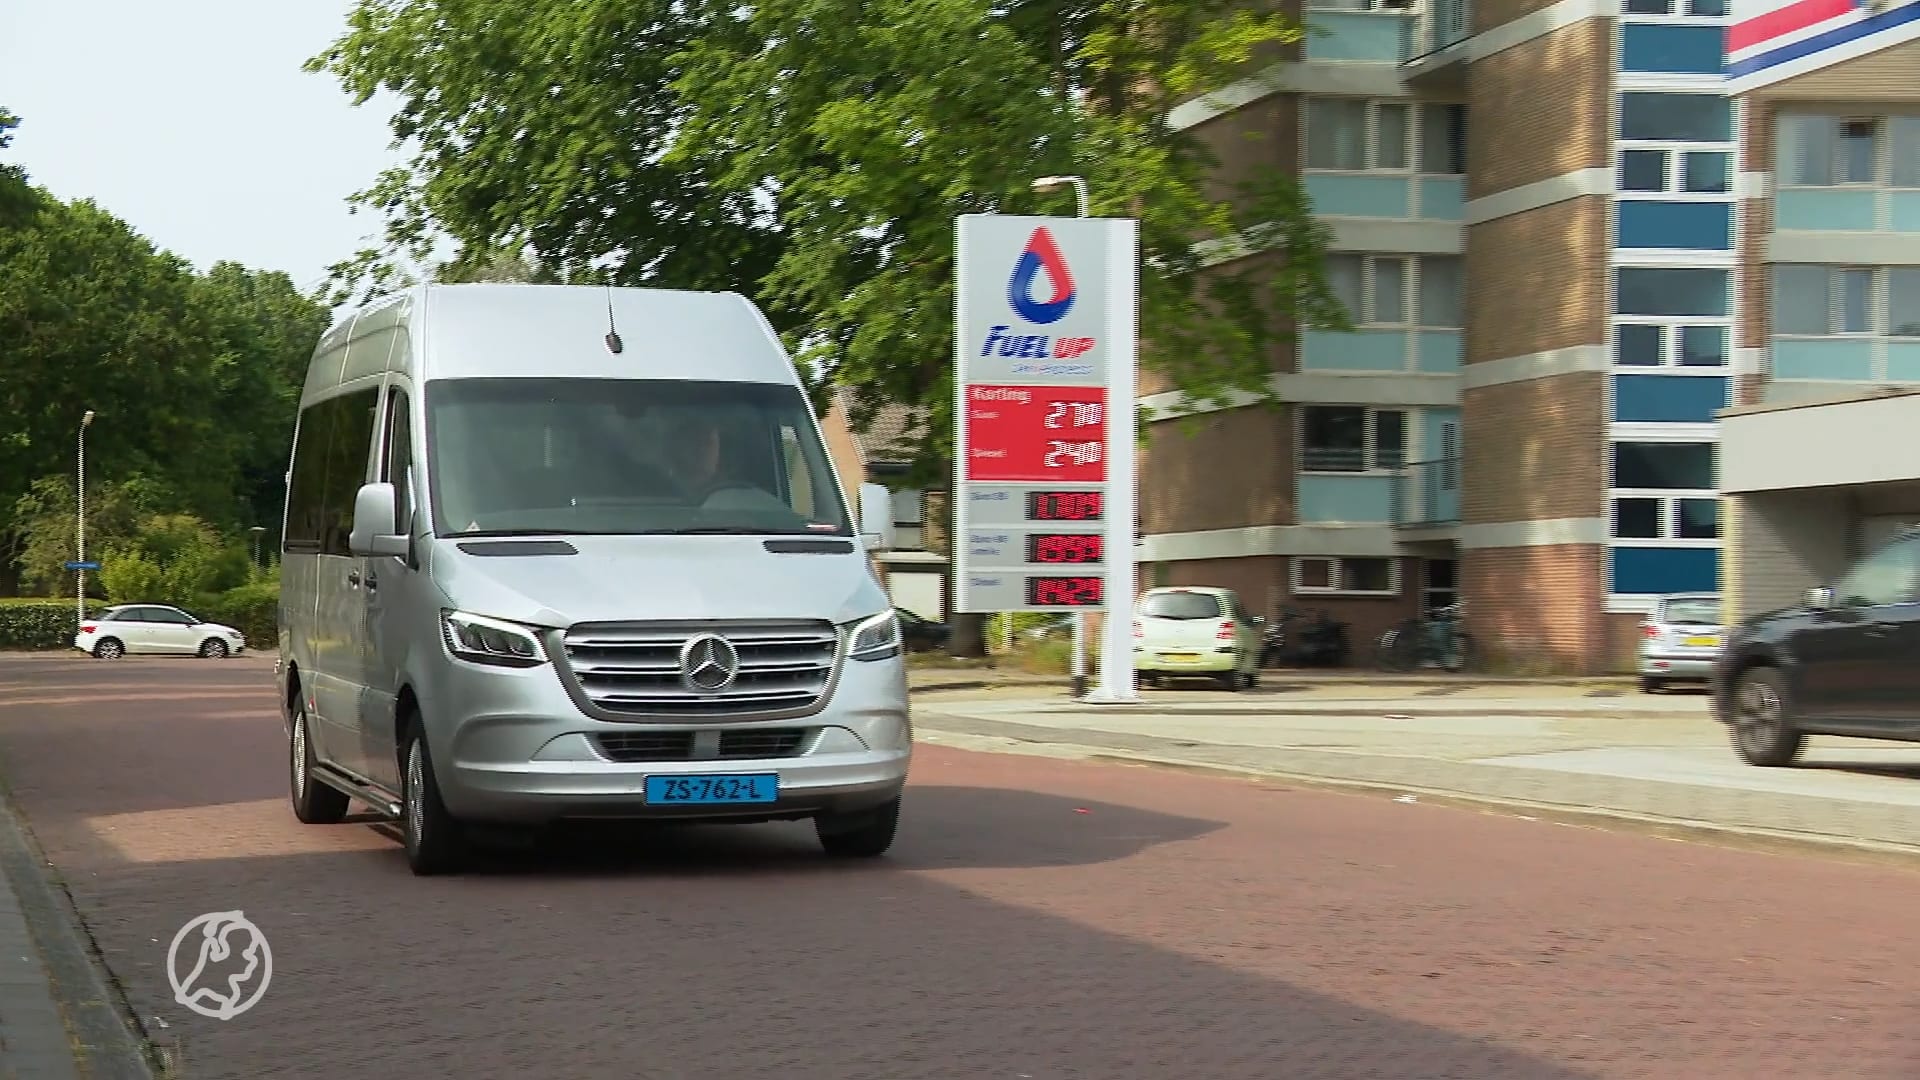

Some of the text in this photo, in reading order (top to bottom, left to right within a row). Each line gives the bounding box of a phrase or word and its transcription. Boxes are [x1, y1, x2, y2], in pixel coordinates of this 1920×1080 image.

[981, 325, 1097, 358] FUEL UP
[973, 387, 1032, 405] Korting
[1044, 401, 1102, 428] 270
[1044, 440, 1102, 466] 240
[663, 778, 762, 800] ZS-762-L
